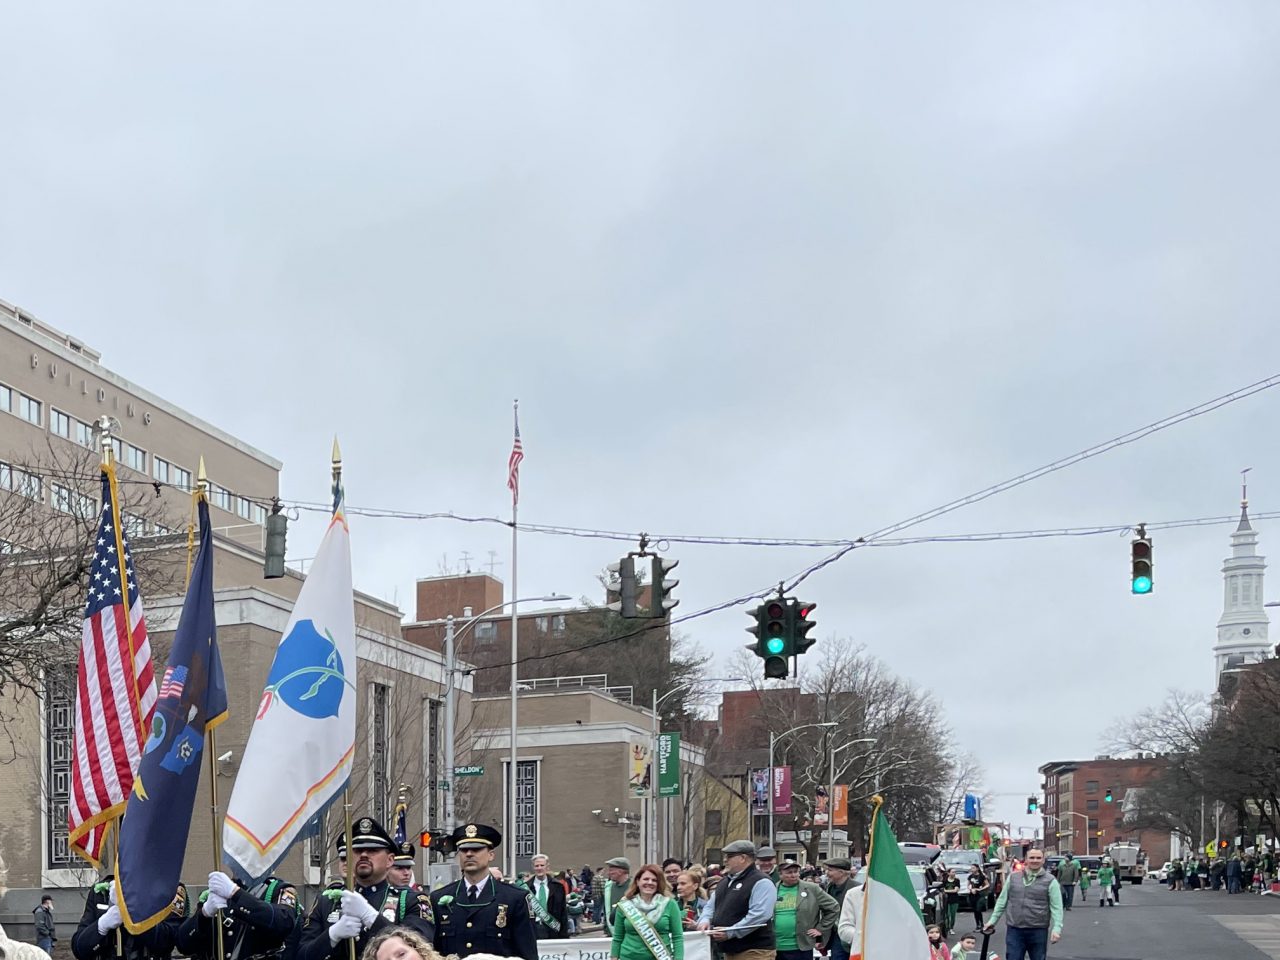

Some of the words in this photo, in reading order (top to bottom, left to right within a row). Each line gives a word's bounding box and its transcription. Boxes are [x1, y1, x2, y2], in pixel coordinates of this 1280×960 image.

[30, 352, 153, 426] BUILDING
[454, 766, 480, 774] SHELDON
[659, 735, 667, 774] HARTFORD
